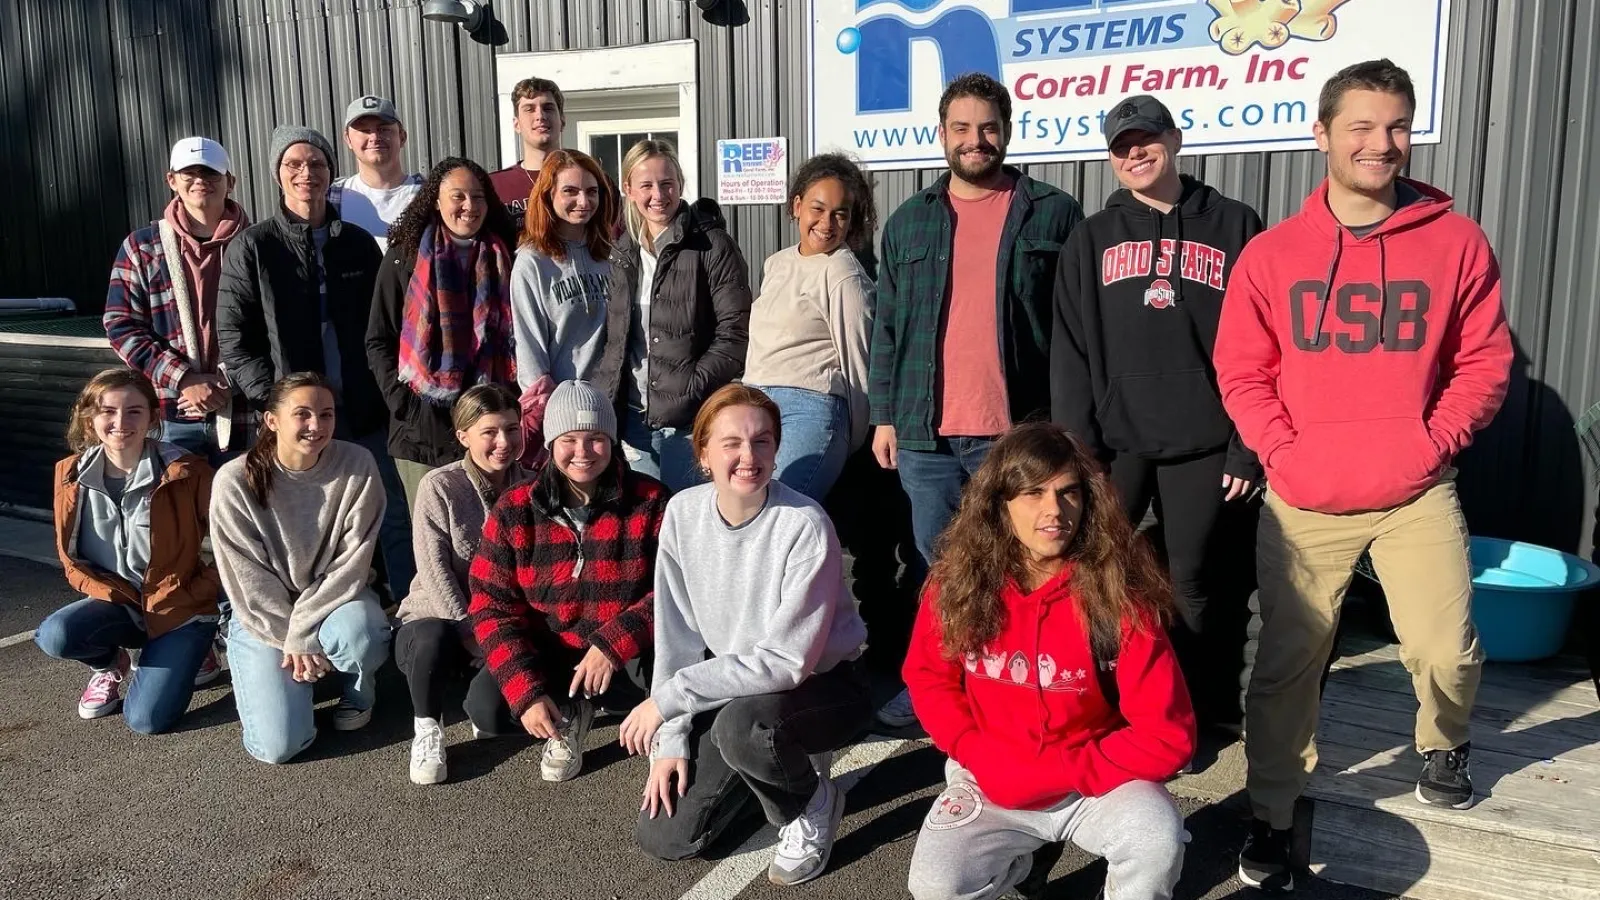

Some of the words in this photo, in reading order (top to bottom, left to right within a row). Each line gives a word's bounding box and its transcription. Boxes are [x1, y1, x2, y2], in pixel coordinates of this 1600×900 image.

[1012, 13, 1187, 57] SYSTEMS
[1014, 65, 1111, 100] Coral
[1121, 64, 1228, 93] Farm,
[1245, 54, 1309, 83] Inc
[363, 96, 379, 109] C
[723, 143, 772, 173] REEF
[750, 179, 784, 187] Operation
[1102, 240, 1153, 286] OHIO
[1155, 239, 1226, 290] STATE
[1289, 280, 1430, 353] CSB
